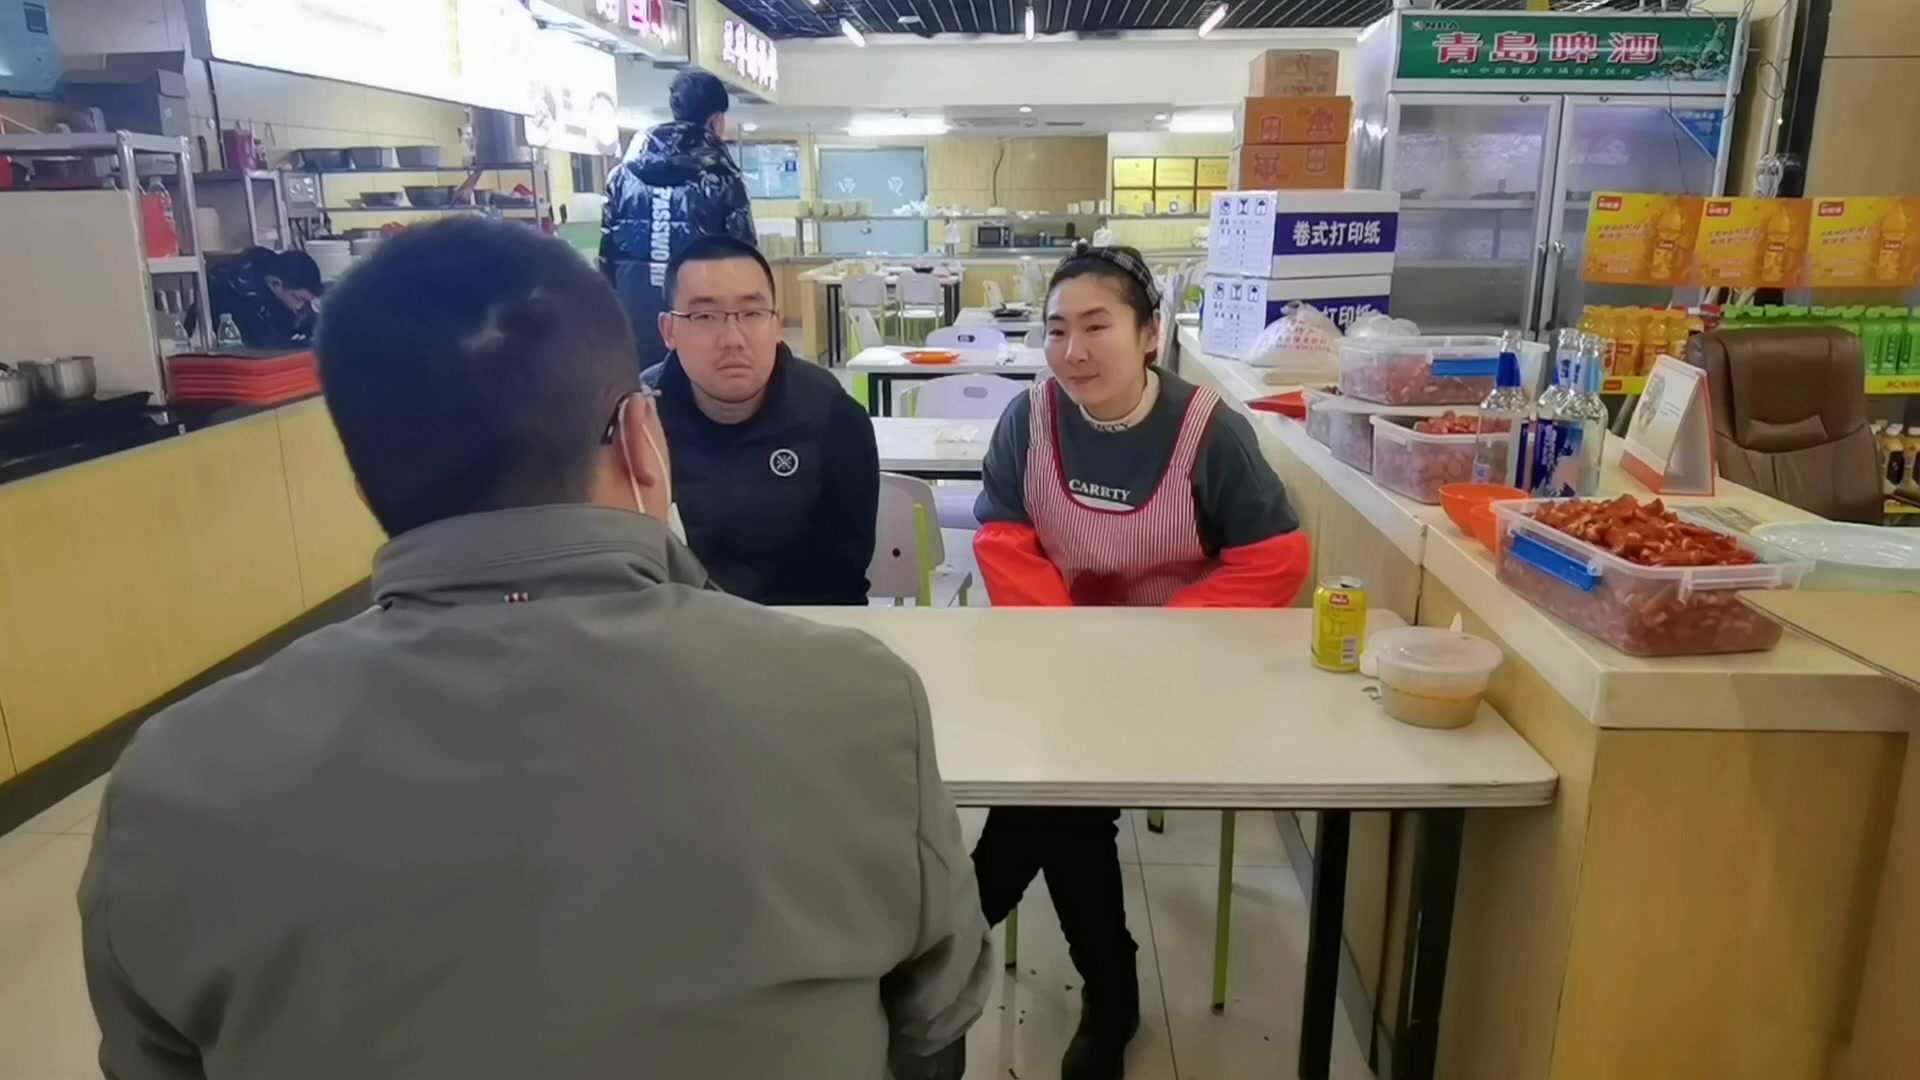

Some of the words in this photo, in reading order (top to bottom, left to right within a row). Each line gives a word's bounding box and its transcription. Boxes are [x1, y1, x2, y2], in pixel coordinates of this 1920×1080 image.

[1293, 220, 1381, 246] 卷式打印纸
[1069, 479, 1131, 501] CARRTY
